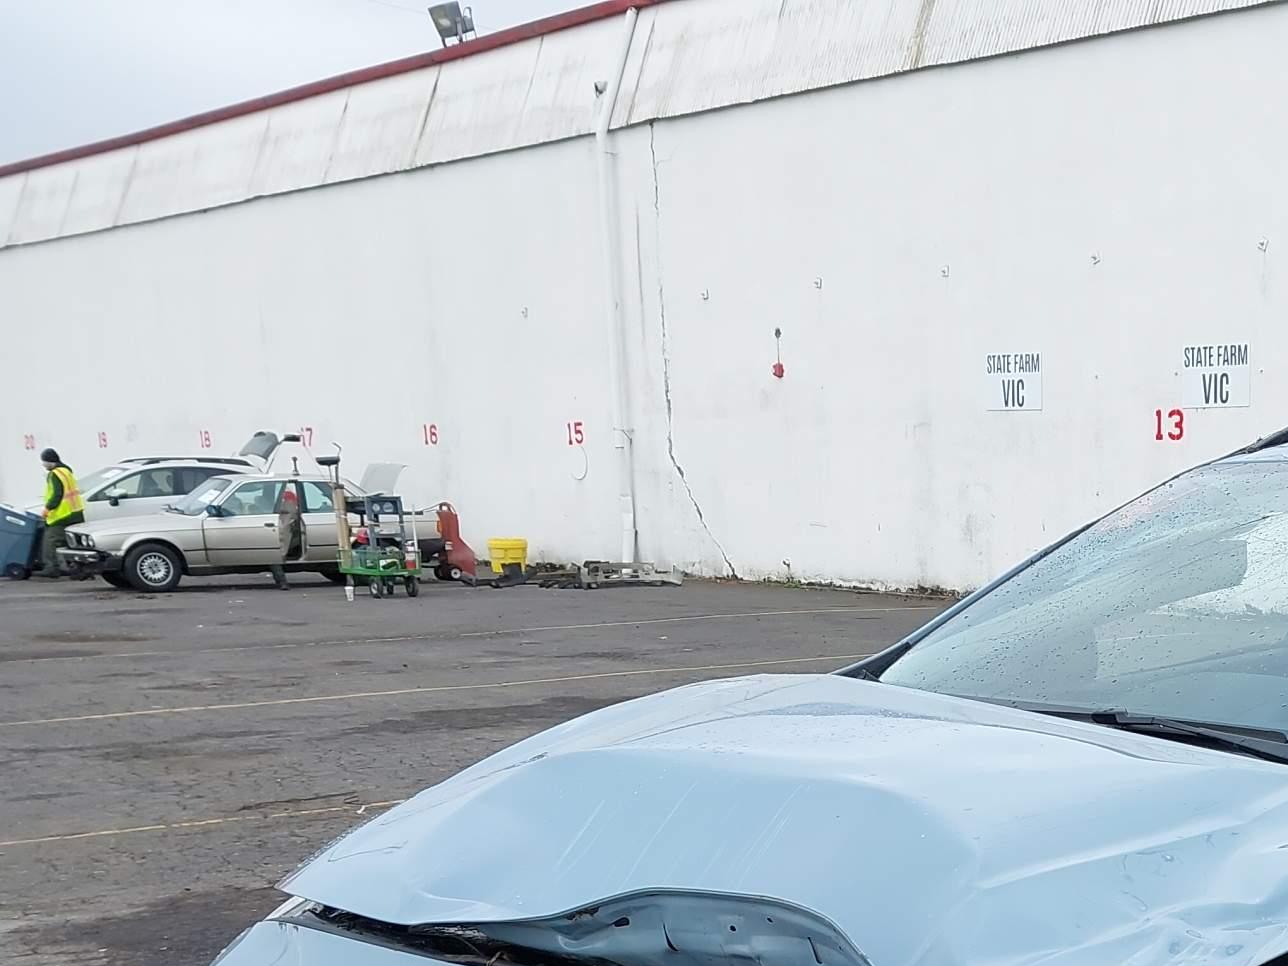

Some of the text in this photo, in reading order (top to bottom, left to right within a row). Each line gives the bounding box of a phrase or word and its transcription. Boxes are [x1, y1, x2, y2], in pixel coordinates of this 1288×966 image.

[986, 353, 1040, 374] STATE FARM
[1184, 343, 1248, 368] STATE FARM
[1002, 378, 1025, 408] VIC
[1202, 372, 1230, 405] VIC
[424, 423, 439, 445] 16
[567, 421, 584, 445] 15
[1155, 408, 1185, 441] 13
[200, 430, 212, 448] 18
[301, 427, 312, 447] 17
